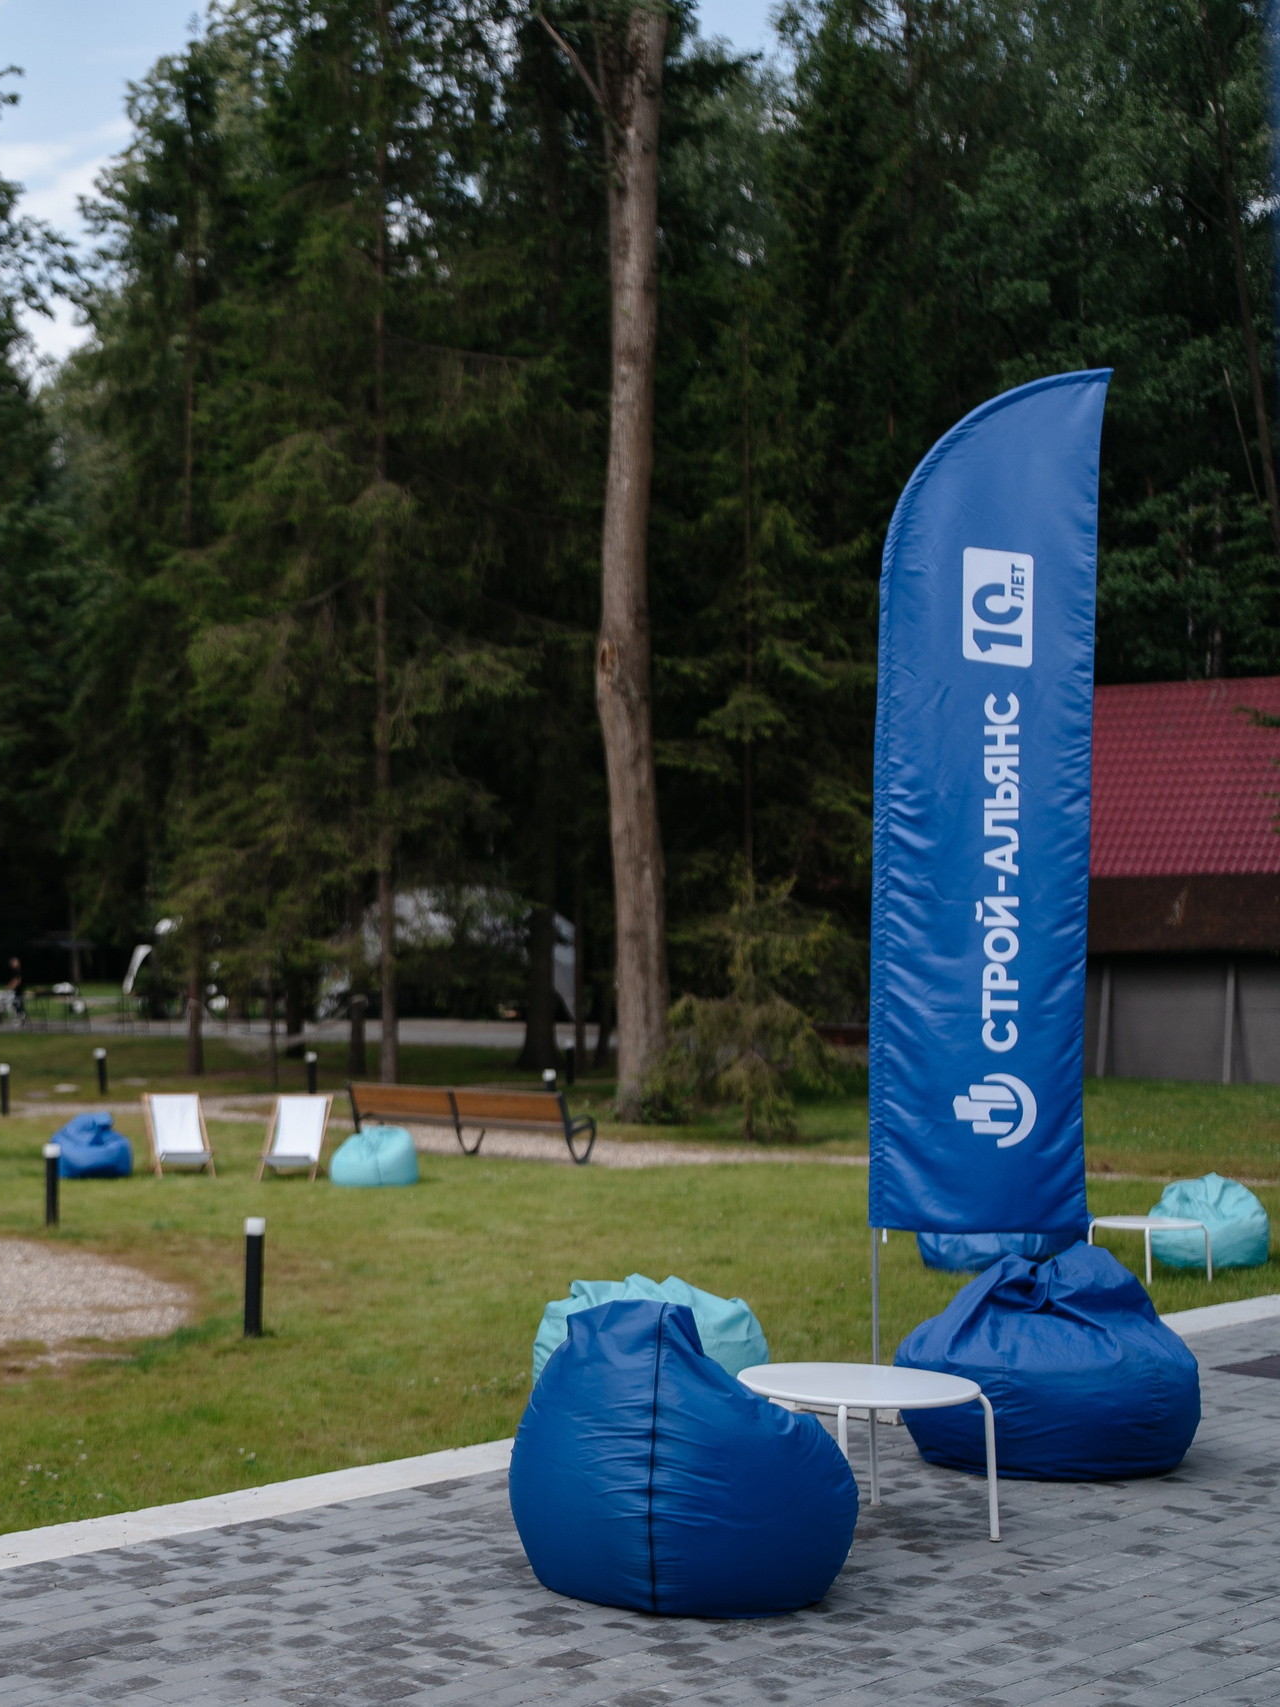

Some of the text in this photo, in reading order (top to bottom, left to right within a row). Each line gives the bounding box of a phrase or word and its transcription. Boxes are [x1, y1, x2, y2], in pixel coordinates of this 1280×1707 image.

[972, 563, 1025, 653] 10 ЛЕТ
[975, 692, 1020, 1052] СТРОЙ-АЛЬЯНС
